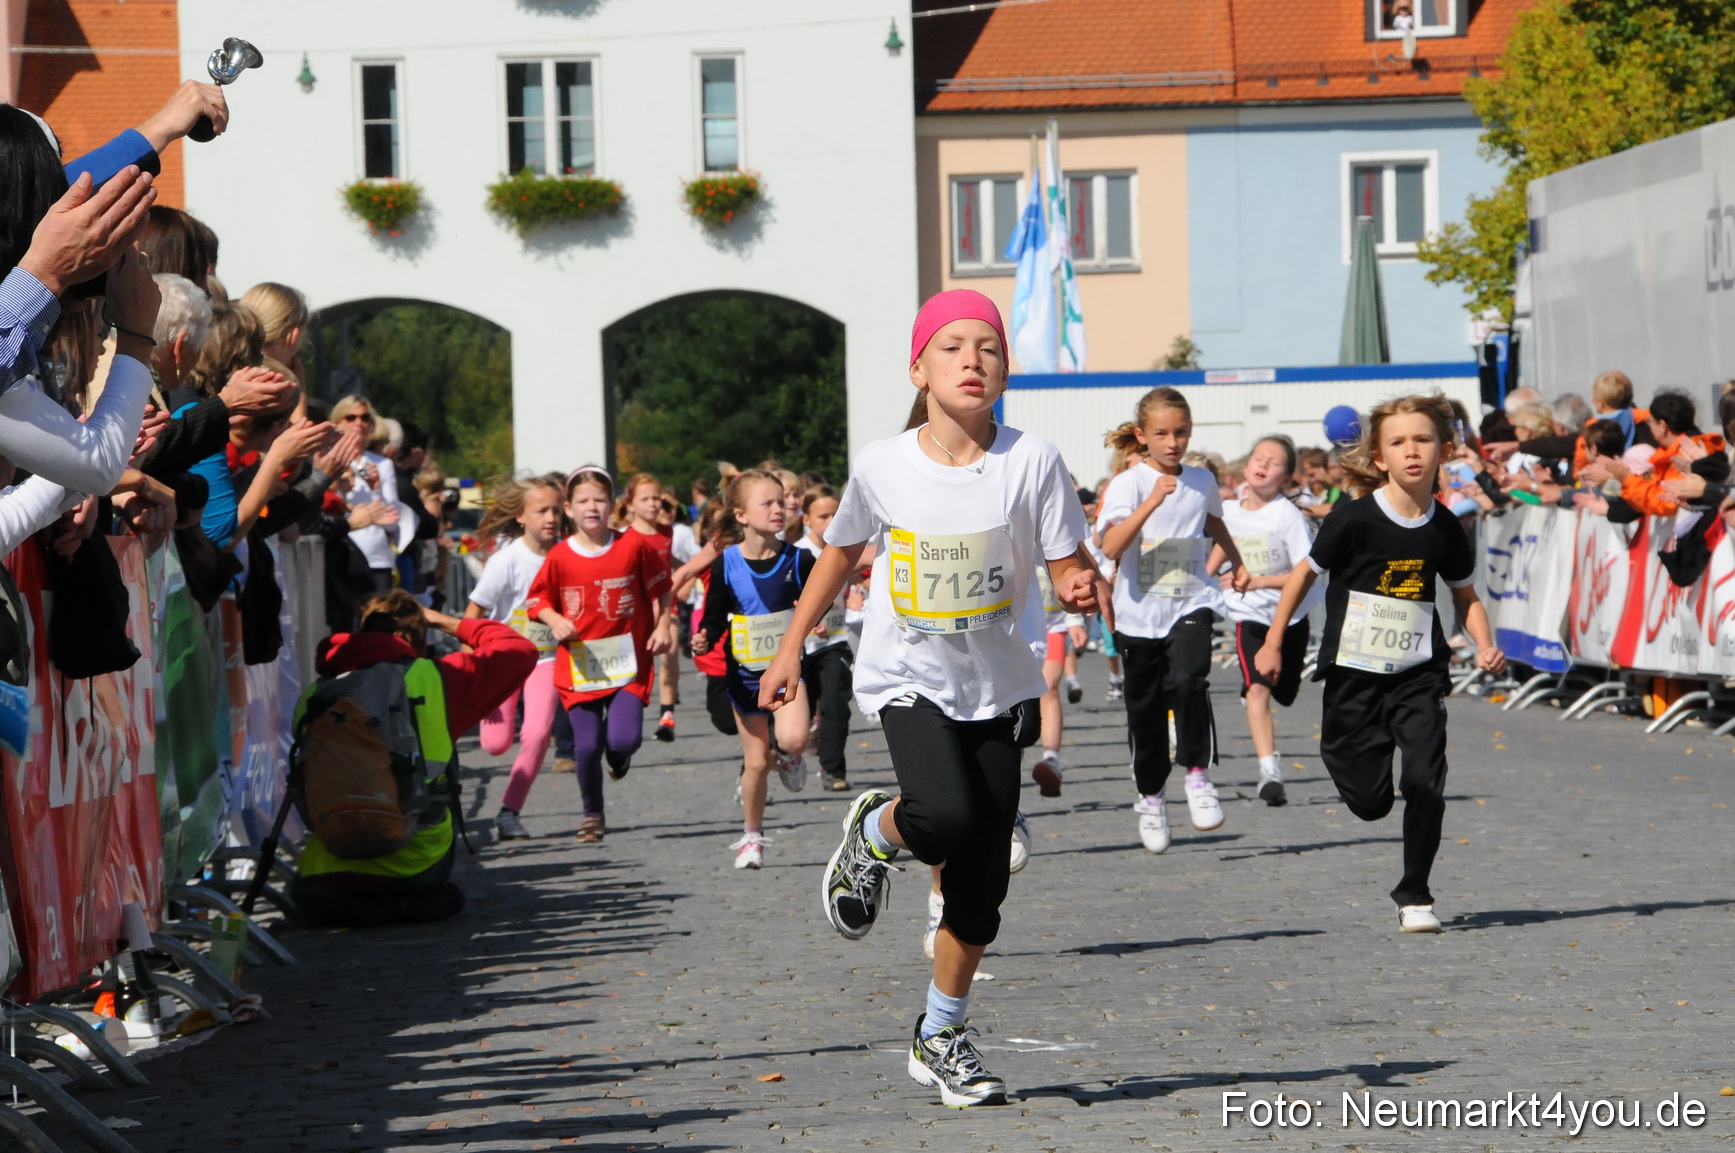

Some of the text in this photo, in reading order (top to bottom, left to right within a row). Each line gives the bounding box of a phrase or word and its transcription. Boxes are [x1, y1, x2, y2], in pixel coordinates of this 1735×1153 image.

[920, 541, 970, 561] Sarah
[1244, 549, 1281, 566] 7185
[895, 567, 909, 583] K3
[923, 565, 1005, 600] 7125
[969, 605, 1012, 624] PFLEIDERER
[1371, 602, 1408, 621] Selina
[750, 618, 783, 632] Jasmin
[527, 628, 554, 642] 720
[1370, 626, 1424, 652] 7087
[589, 654, 630, 673] 7008
